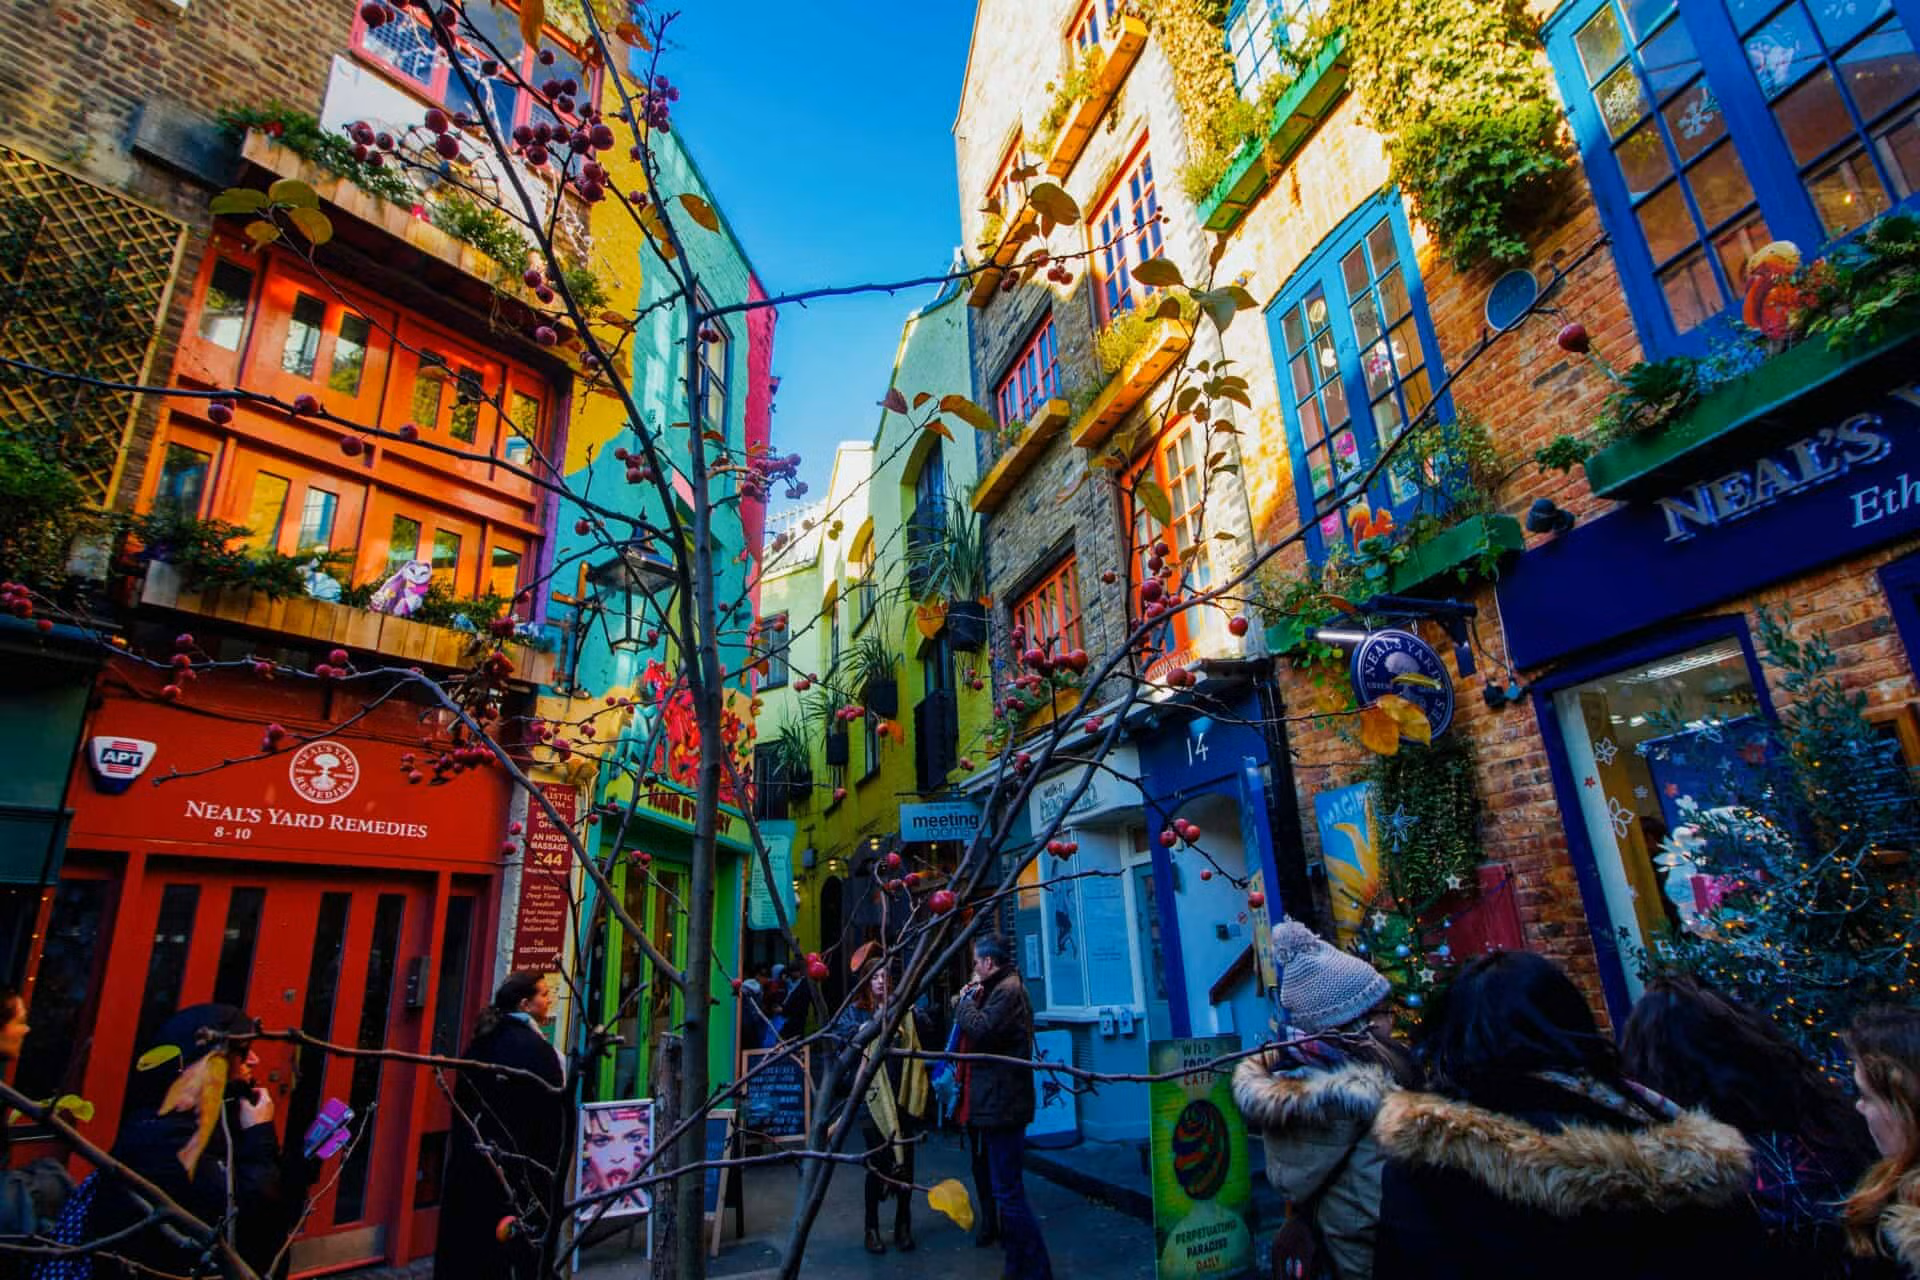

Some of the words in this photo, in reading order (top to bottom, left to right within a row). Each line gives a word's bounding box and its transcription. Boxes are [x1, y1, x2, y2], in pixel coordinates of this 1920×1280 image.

[1654, 412, 1890, 542] NEAL'S
[1365, 638, 1402, 677] NEAL'S
[103, 750, 142, 765] APT
[1187, 733, 1208, 767] 14
[295, 776, 351, 799] REMEDIES
[184, 800, 262, 824] NEAL'S
[268, 808, 324, 830] YARD
[330, 814, 429, 839] REMEDIES
[912, 812, 979, 830] meeting
[529, 841, 569, 852] MASSAGE
[532, 833, 545, 841] AN
